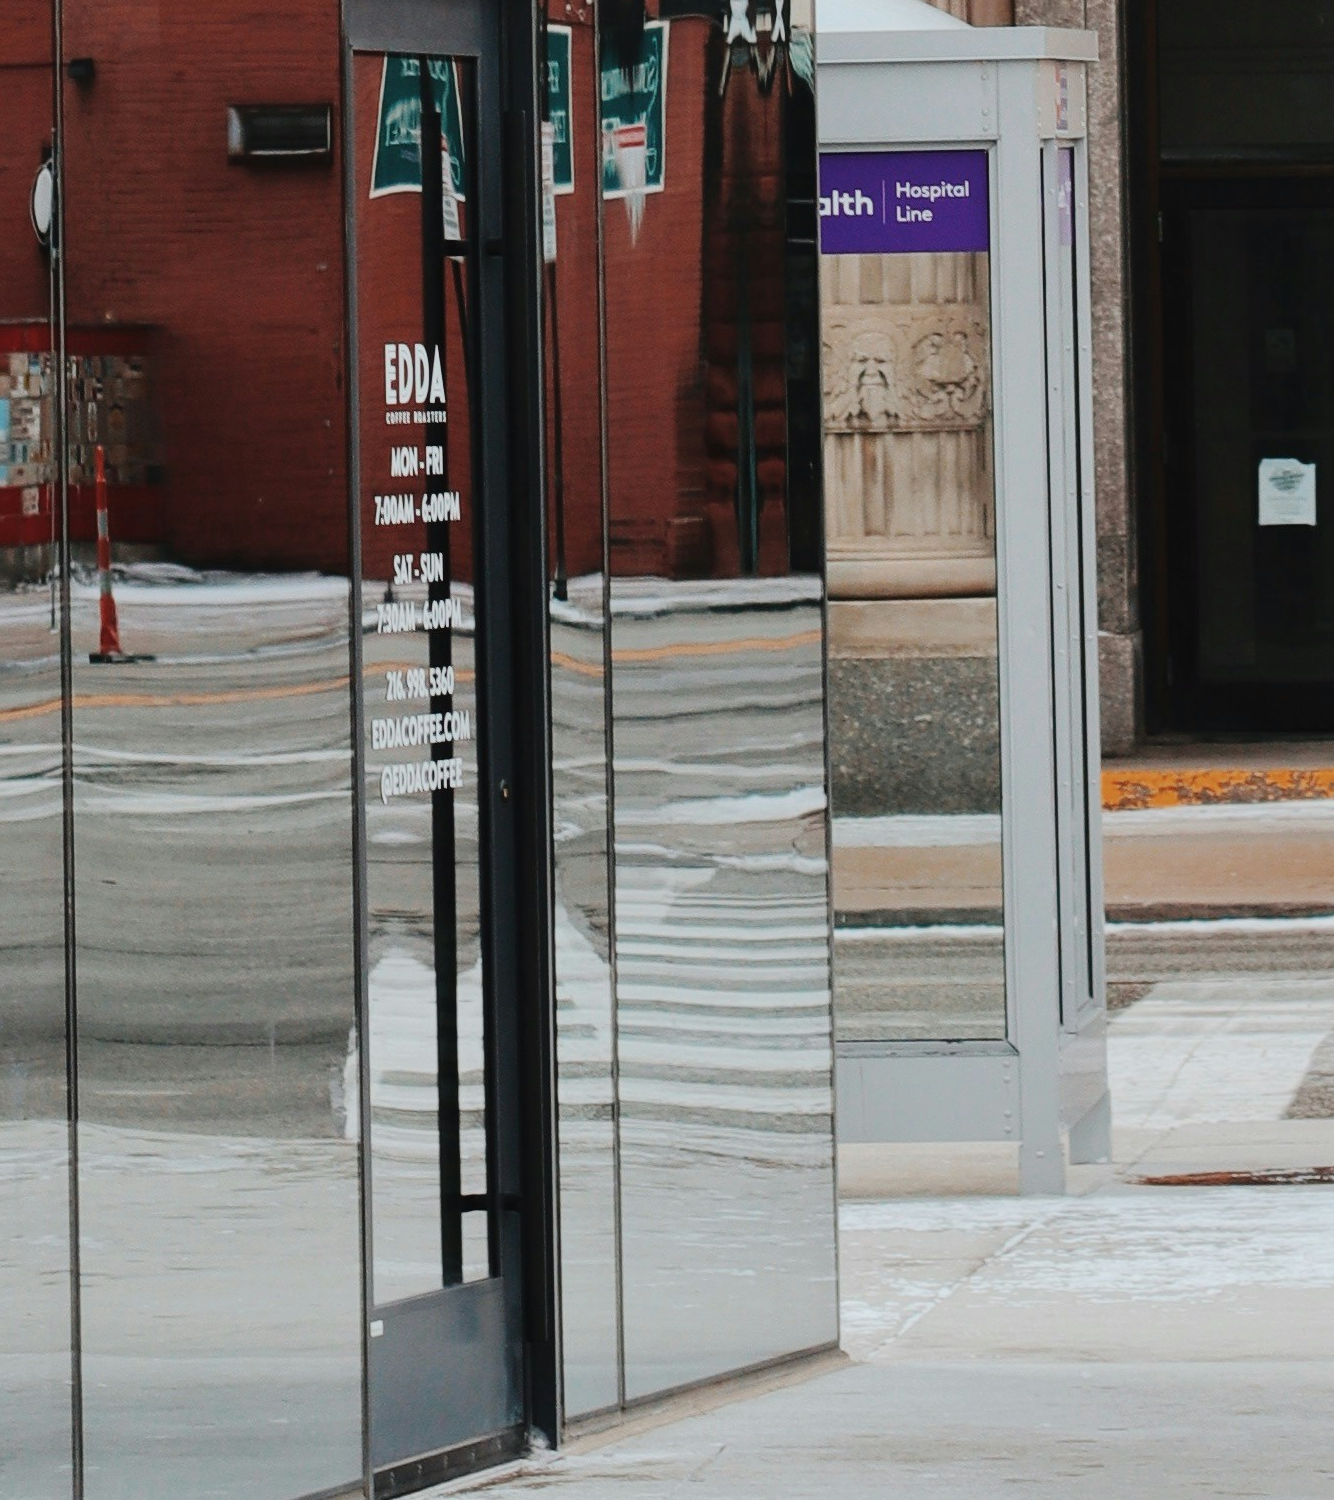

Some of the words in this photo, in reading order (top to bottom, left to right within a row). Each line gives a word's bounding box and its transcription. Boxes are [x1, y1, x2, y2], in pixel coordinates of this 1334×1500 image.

[895, 180, 970, 202] Hospital
[896, 205, 934, 223] Line
[384, 343, 446, 405] EDDA
[385, 411, 411, 425] COFFEE
[413, 410, 447, 424] ROASTERS
[371, 709, 471, 750] EDDACOFFEE.COM
[380, 757, 464, 805] @EDDACOFFEE
